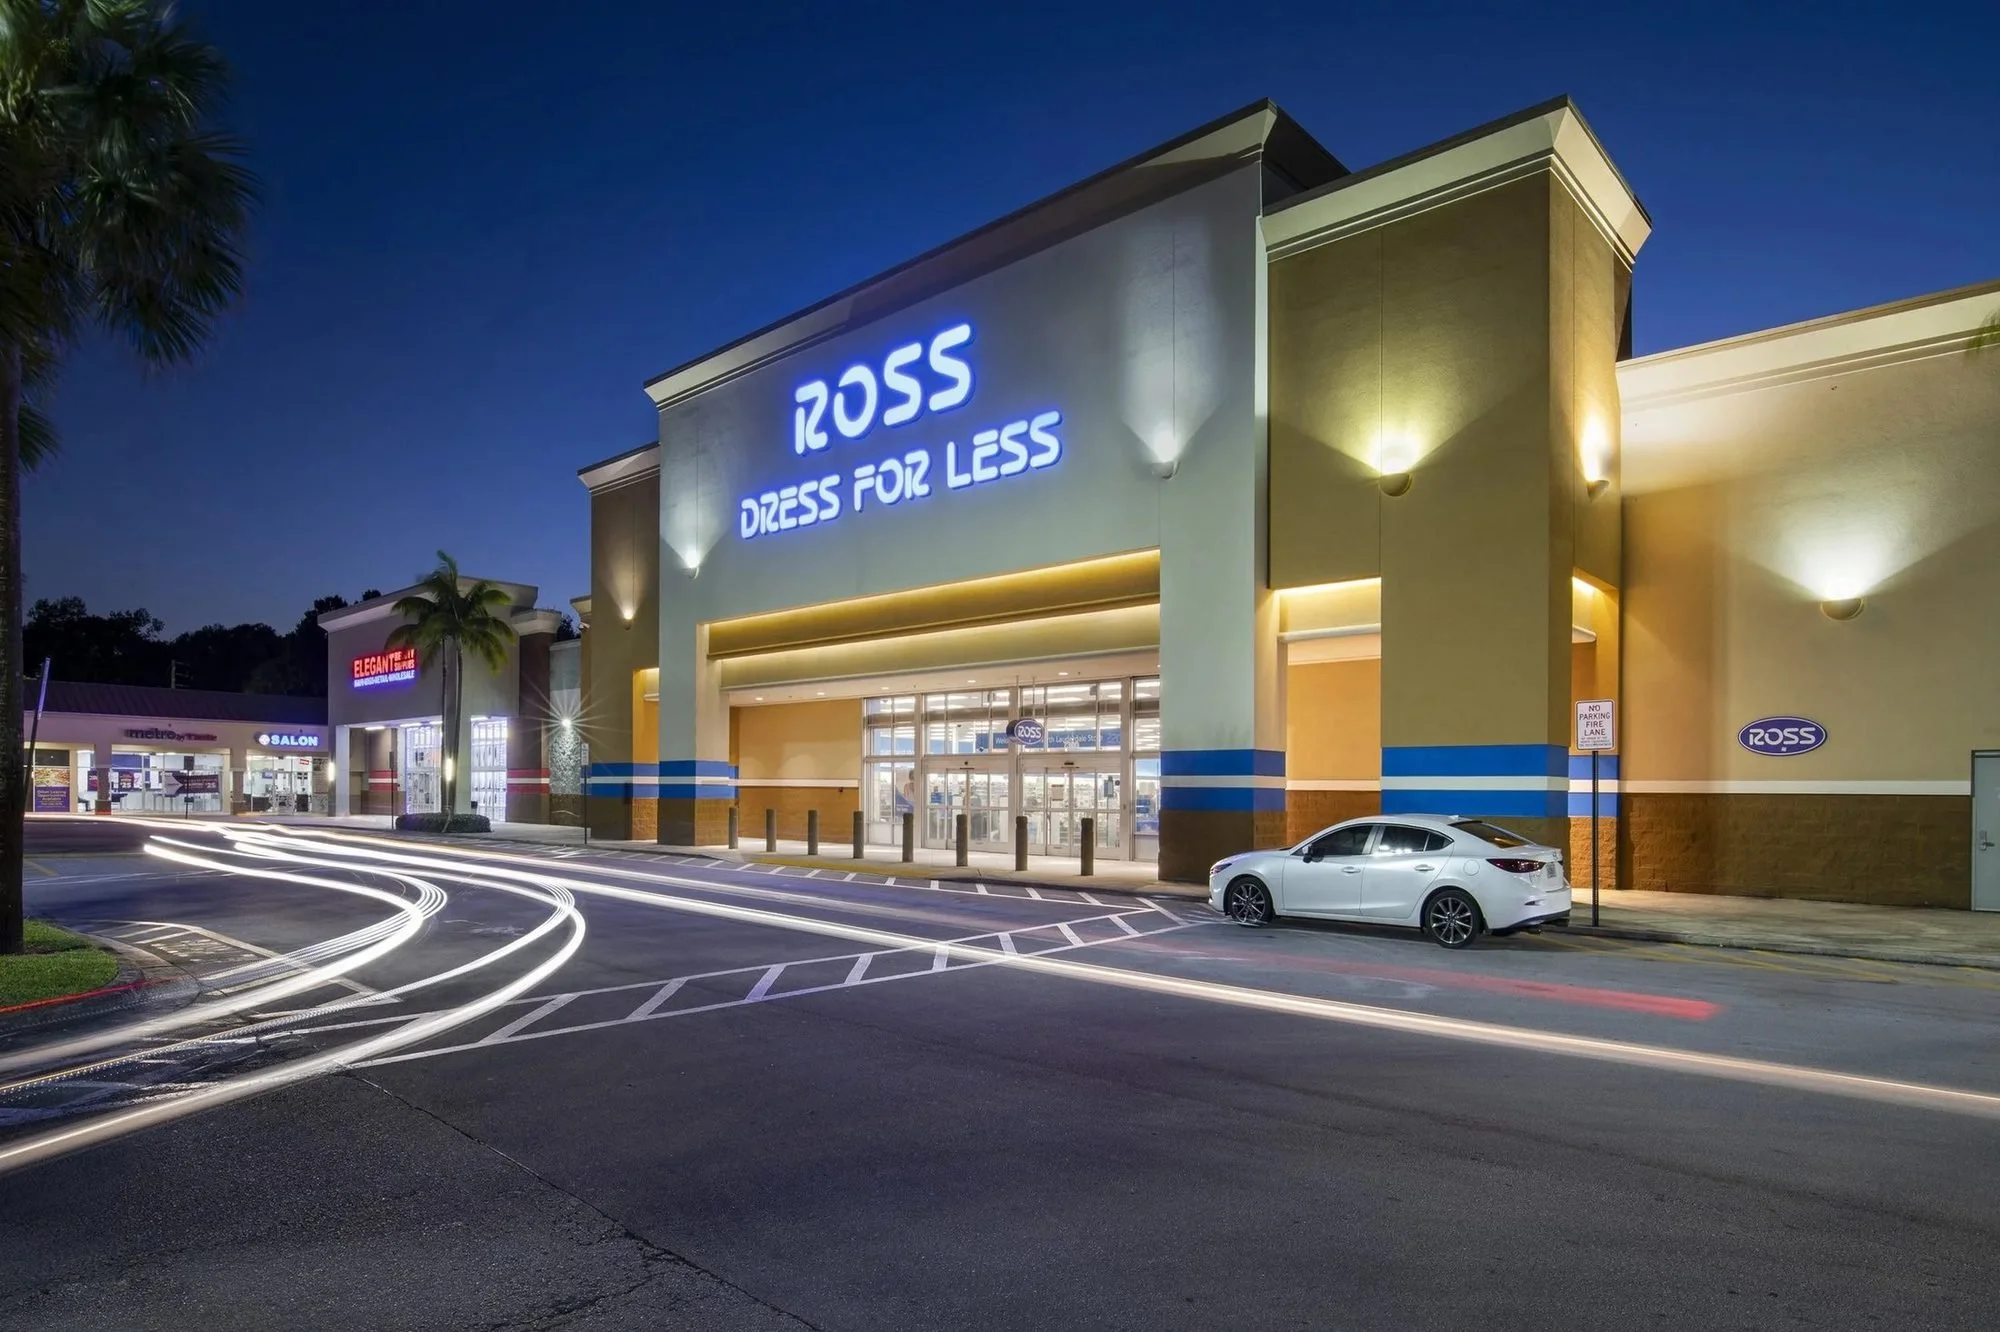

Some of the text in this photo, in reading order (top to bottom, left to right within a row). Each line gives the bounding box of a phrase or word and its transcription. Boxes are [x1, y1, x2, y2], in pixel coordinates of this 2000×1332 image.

[795, 323, 970, 454] ROSS
[741, 410, 1061, 539] DRESS FOR LESS
[354, 653, 395, 678] ELEGANT
[1588, 704, 1601, 712] NO
[1579, 712, 1611, 721] PARKING
[1585, 720, 1604, 728] FIRE
[1018, 725, 1042, 739] ROSS
[1584, 728, 1606, 737] LANE
[1748, 727, 1816, 745] ROSS
[270, 734, 319, 747] SALON
